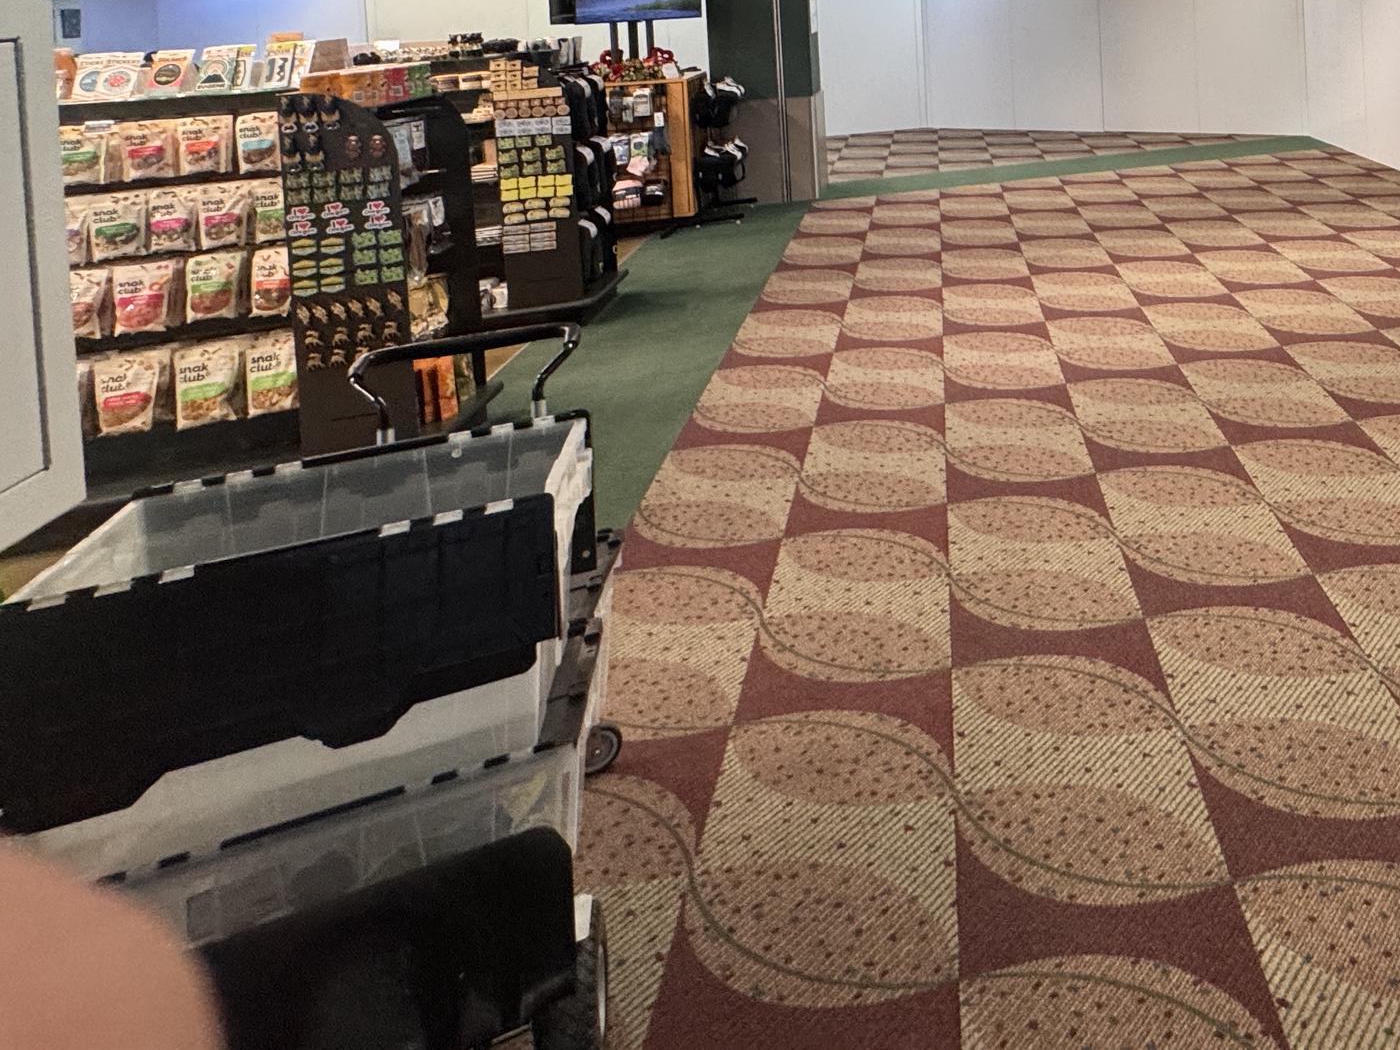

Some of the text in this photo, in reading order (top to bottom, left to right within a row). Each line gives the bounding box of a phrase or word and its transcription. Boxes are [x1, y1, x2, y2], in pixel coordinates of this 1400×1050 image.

[93, 215, 117, 223] club
[118, 279, 145, 287] snak
[252, 352, 280, 364] snak
[179, 362, 208, 374] snak
[179, 372, 206, 383] club
